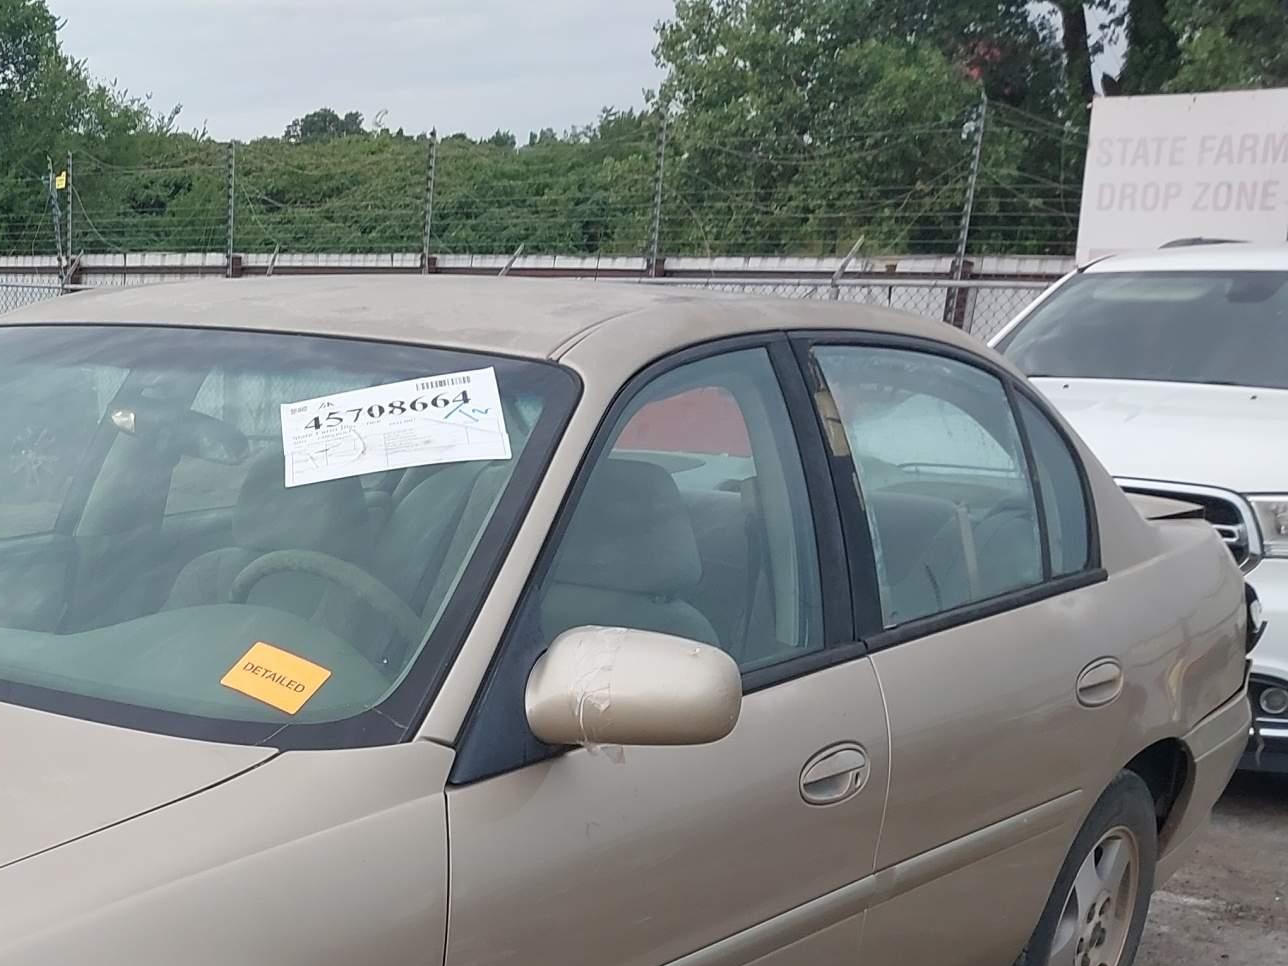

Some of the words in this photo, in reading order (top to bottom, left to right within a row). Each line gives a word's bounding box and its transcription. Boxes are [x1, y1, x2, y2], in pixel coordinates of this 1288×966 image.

[1096, 135, 1187, 168] STATE
[1197, 132, 1288, 167] FARM
[1096, 180, 1183, 213] DROP
[1191, 179, 1281, 212] ZONE
[303, 389, 472, 431] 45708664
[242, 661, 306, 694] DETAILED
